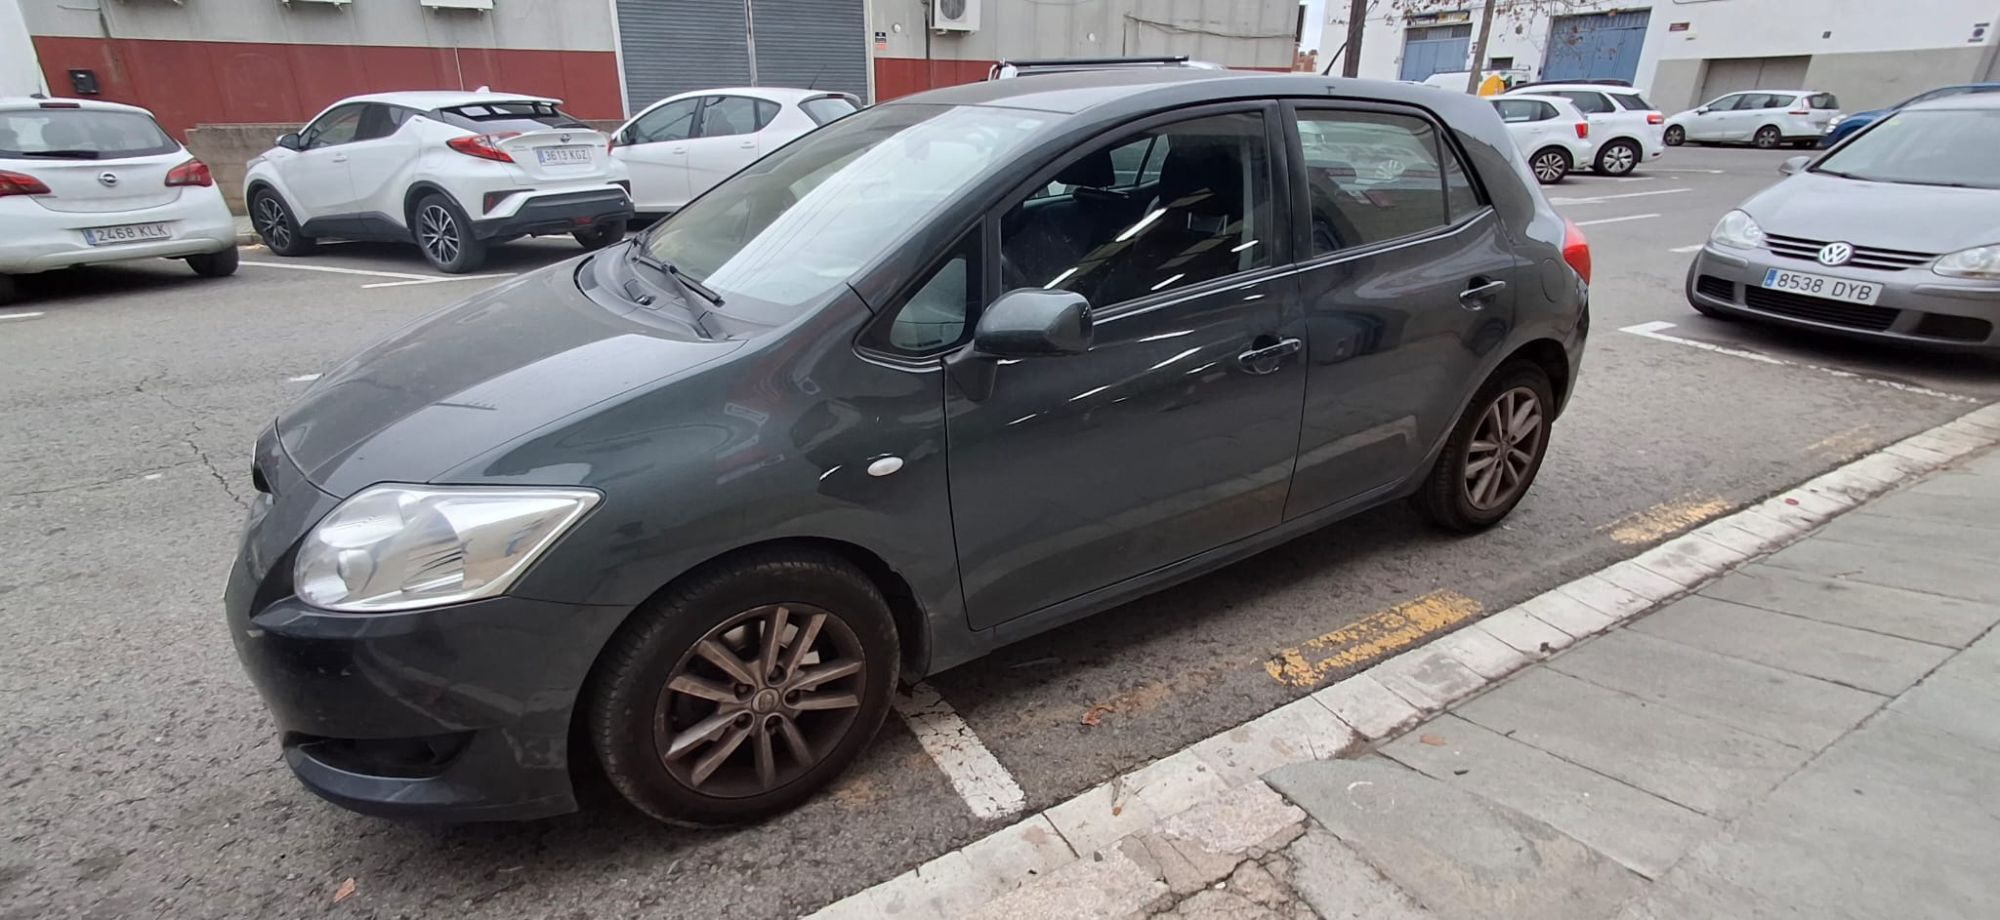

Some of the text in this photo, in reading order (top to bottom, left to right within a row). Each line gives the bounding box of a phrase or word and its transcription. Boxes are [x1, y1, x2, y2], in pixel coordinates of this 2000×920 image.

[544, 150, 568, 161] 3613
[96, 223, 168, 241] 2468 KLK
[1777, 273, 1873, 301] 8538 DYB
